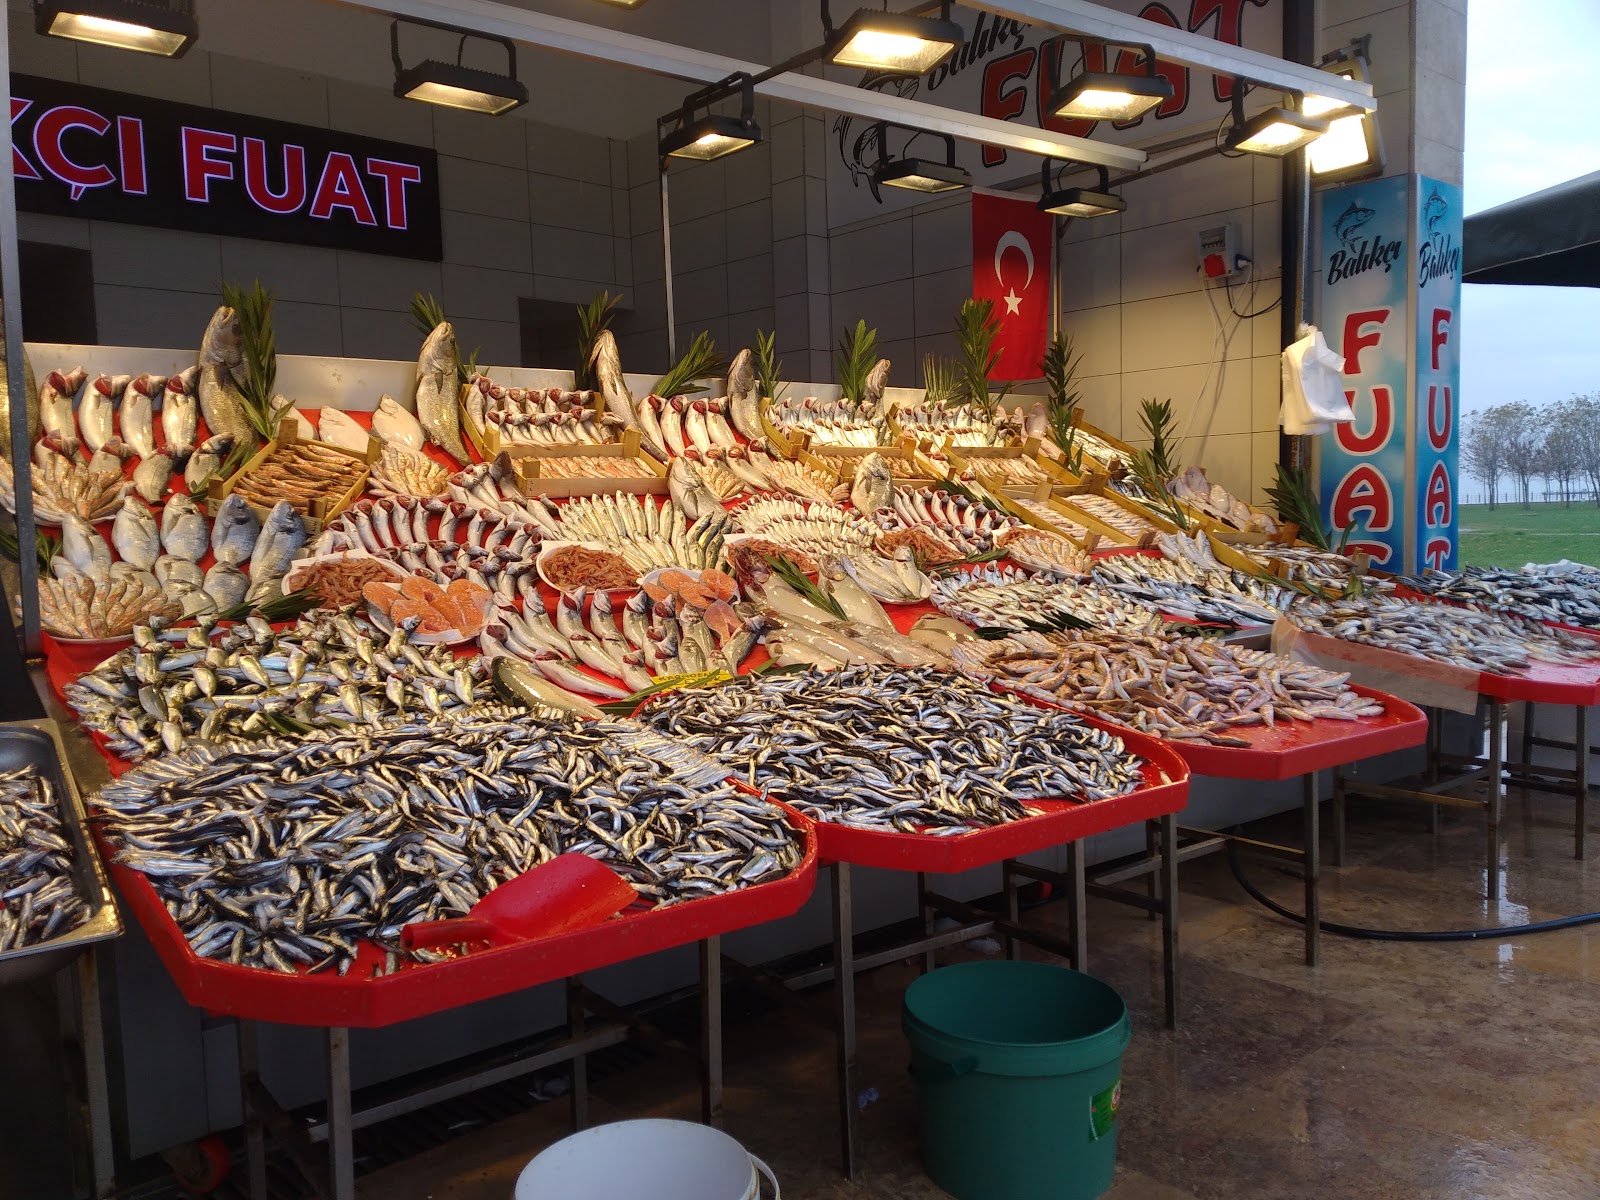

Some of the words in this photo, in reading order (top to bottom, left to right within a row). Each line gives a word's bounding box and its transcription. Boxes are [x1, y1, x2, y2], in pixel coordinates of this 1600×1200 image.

[180, 126, 422, 230] FUAT
[1327, 235, 1402, 285] Balıkçı
[1419, 234, 1460, 288] Balıkçı
[1425, 307, 1452, 570] FUAT
